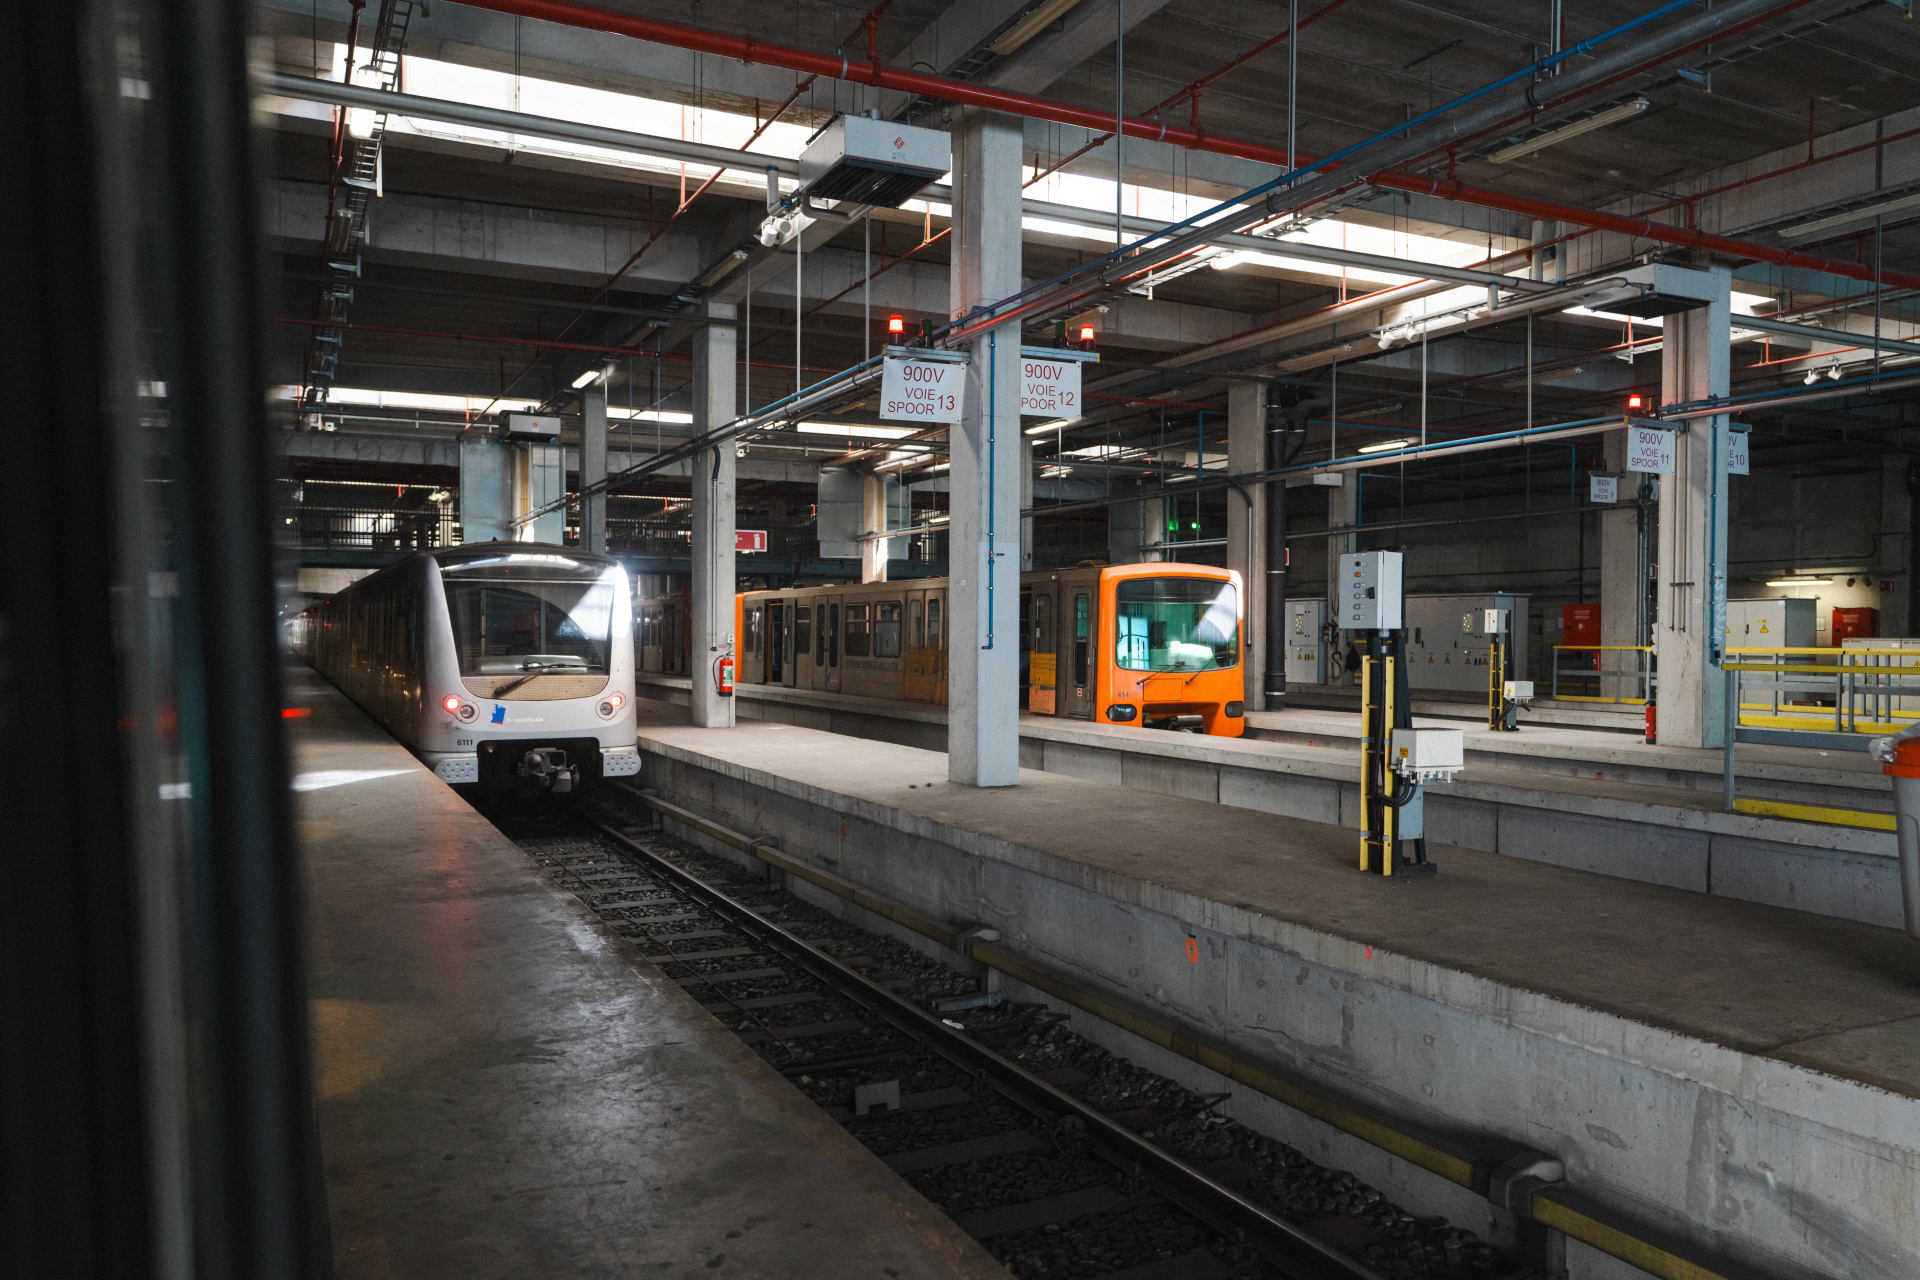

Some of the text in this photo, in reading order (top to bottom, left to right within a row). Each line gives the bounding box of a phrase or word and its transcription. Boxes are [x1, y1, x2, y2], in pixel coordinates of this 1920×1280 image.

[903, 365, 945, 384] 900V
[1025, 363, 1063, 381] 900V
[905, 387, 936, 401] VOIE
[1028, 383, 1056, 397] VOIE
[937, 394, 955, 411] 13
[1021, 396, 1056, 411] POOR
[1058, 391, 1075, 407] 12
[887, 400, 935, 415] SPOOR
[1639, 431, 1664, 446] 900V
[1640, 447, 1659, 458] VOIE
[1660, 453, 1670, 465] 11
[1735, 454, 1745, 466] 10
[1631, 457, 1659, 468] SPOOR
